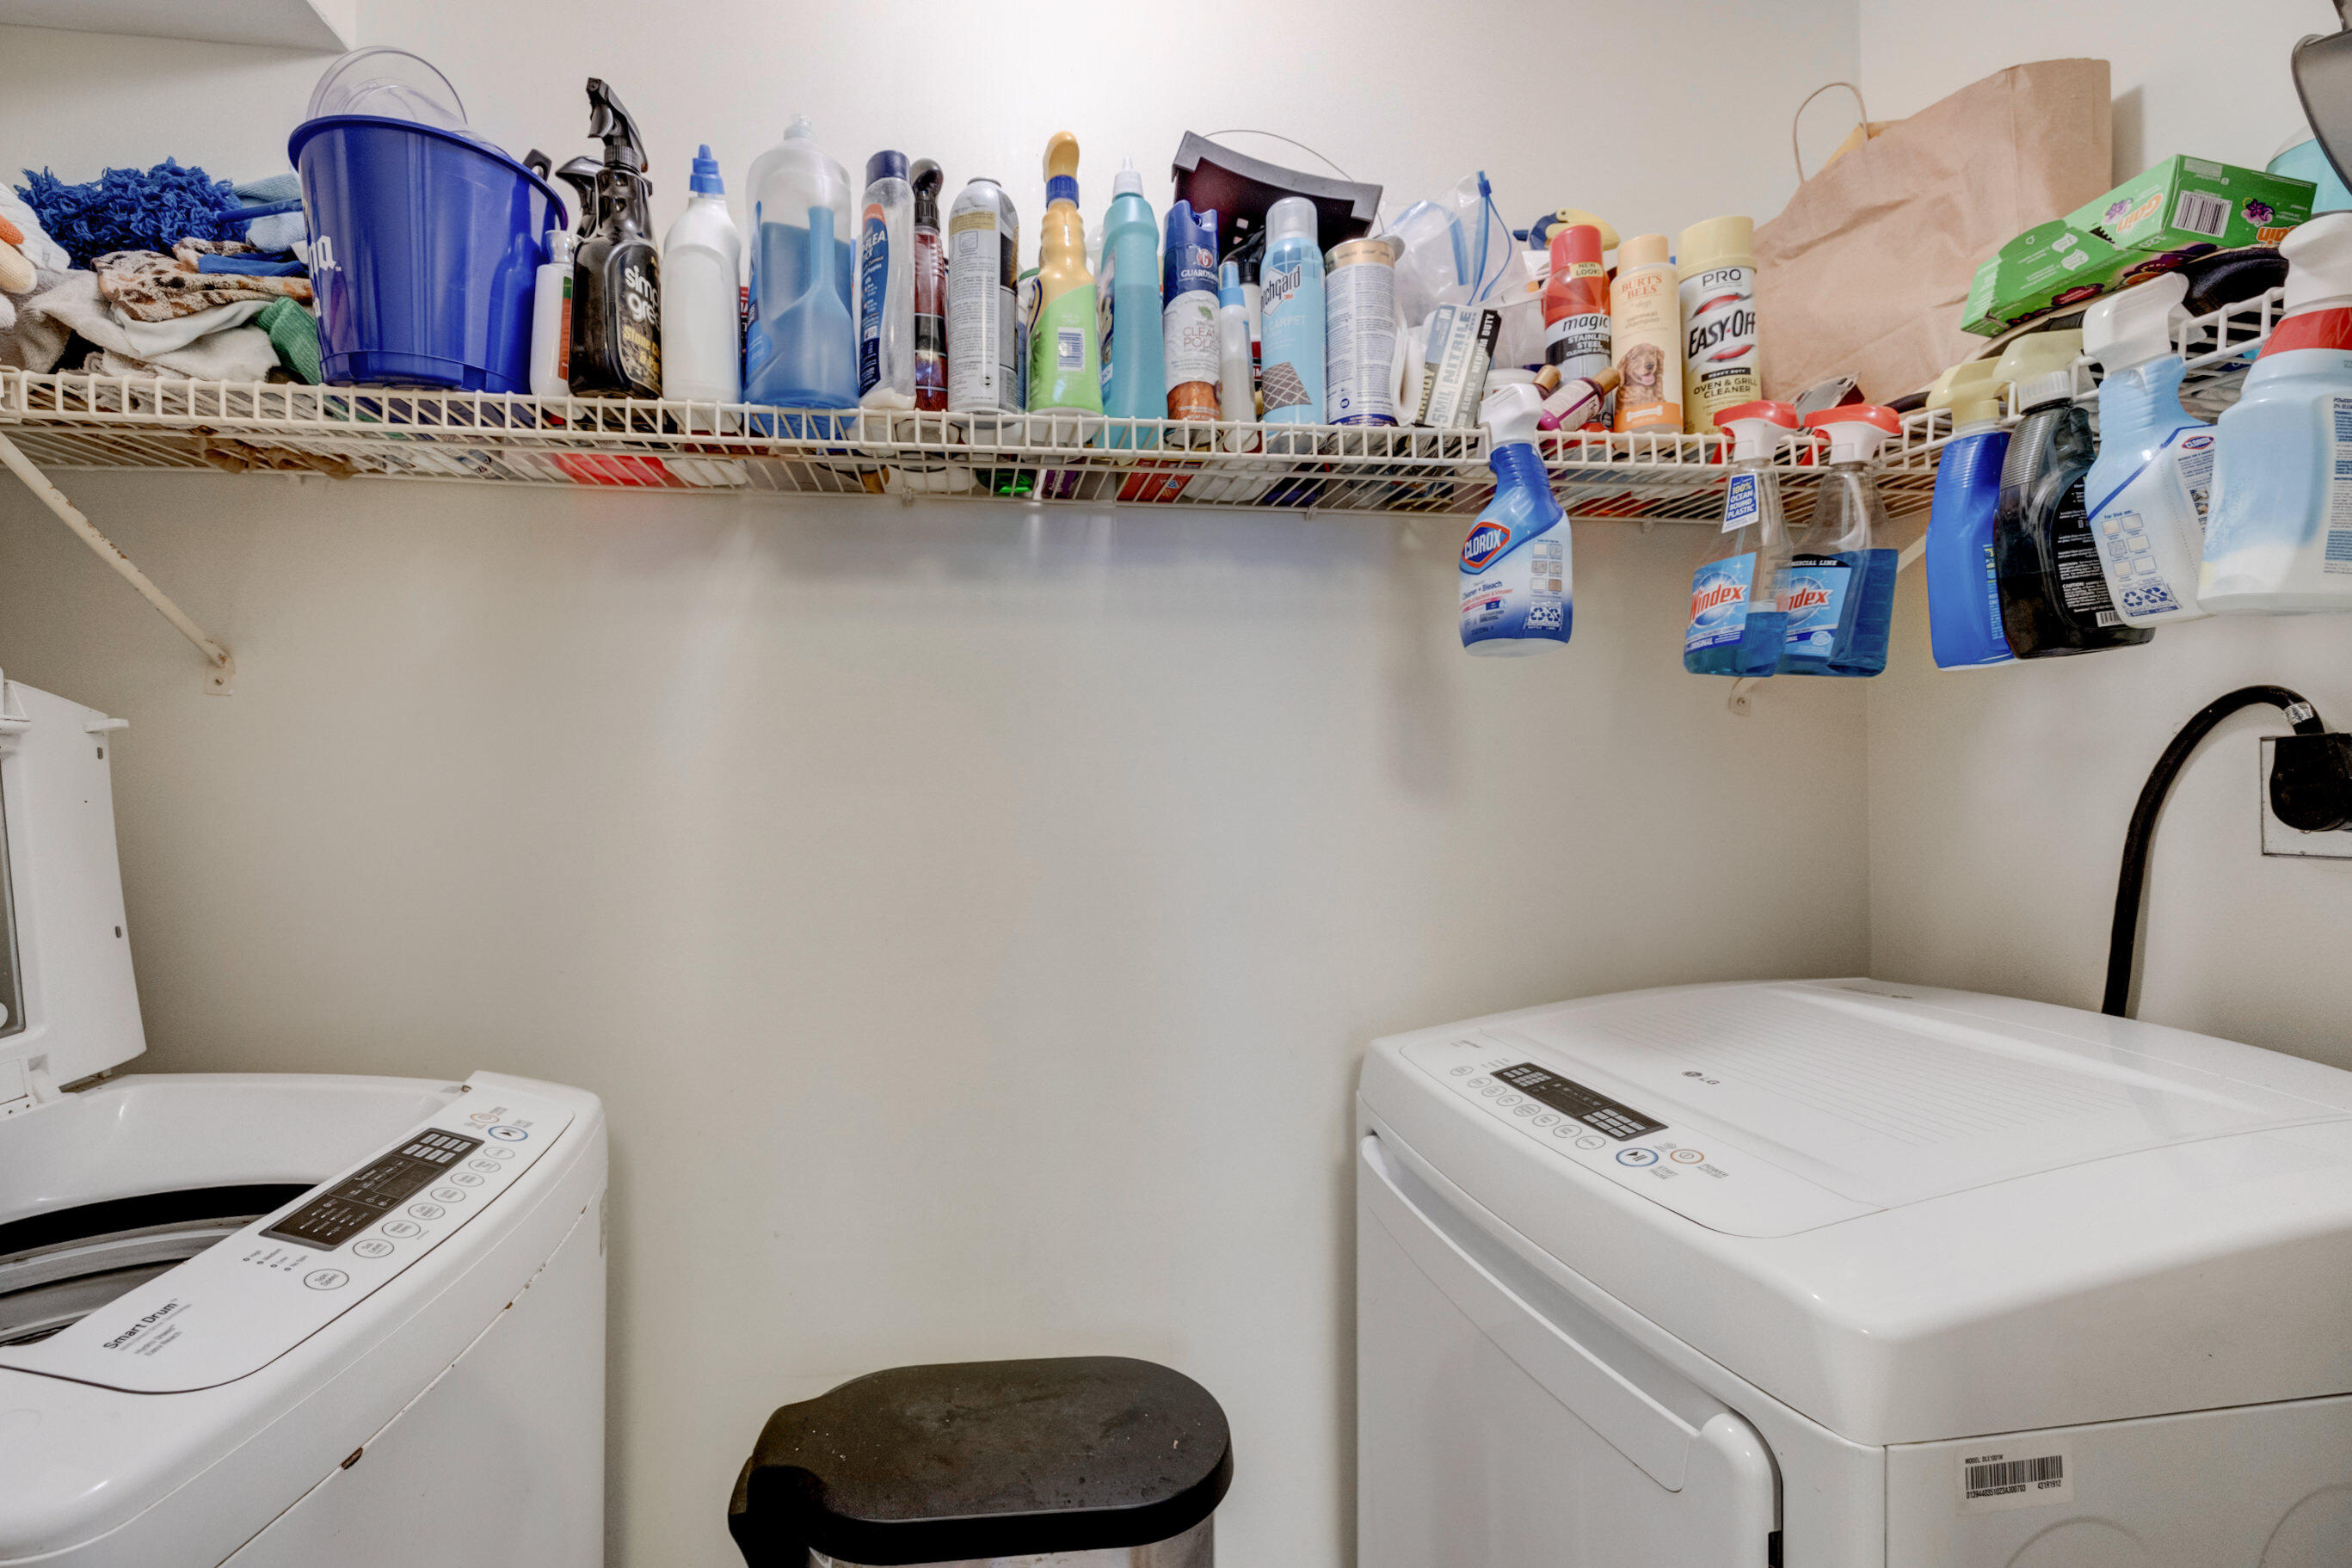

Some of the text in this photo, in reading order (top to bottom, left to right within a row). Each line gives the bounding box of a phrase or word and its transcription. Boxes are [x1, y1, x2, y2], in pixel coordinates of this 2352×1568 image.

[2257, 225, 2298, 245] ain
[1622, 274, 1662, 292] BURT'S
[1702, 268, 1741, 287] PRO
[1628, 286, 1658, 300] BEES
[1562, 316, 1609, 333] magic
[1443, 311, 1473, 384] NITRILE
[1472, 338, 1488, 373] MEDIUM
[1481, 313, 1496, 336] DUTY
[1577, 341, 1603, 349] STEEL
[1708, 370, 1729, 378] HEAVY
[1693, 380, 1721, 395] OVEN
[1703, 385, 1751, 399] CLEANER
[1730, 489, 1753, 504] OCEAN
[1727, 504, 1756, 519] PLASTIC
[1729, 498, 1753, 512] BOUND
[1464, 528, 1502, 560] CLOROX
[1482, 581, 1503, 593] Bleach
[103, 1323, 148, 1350] Smart
